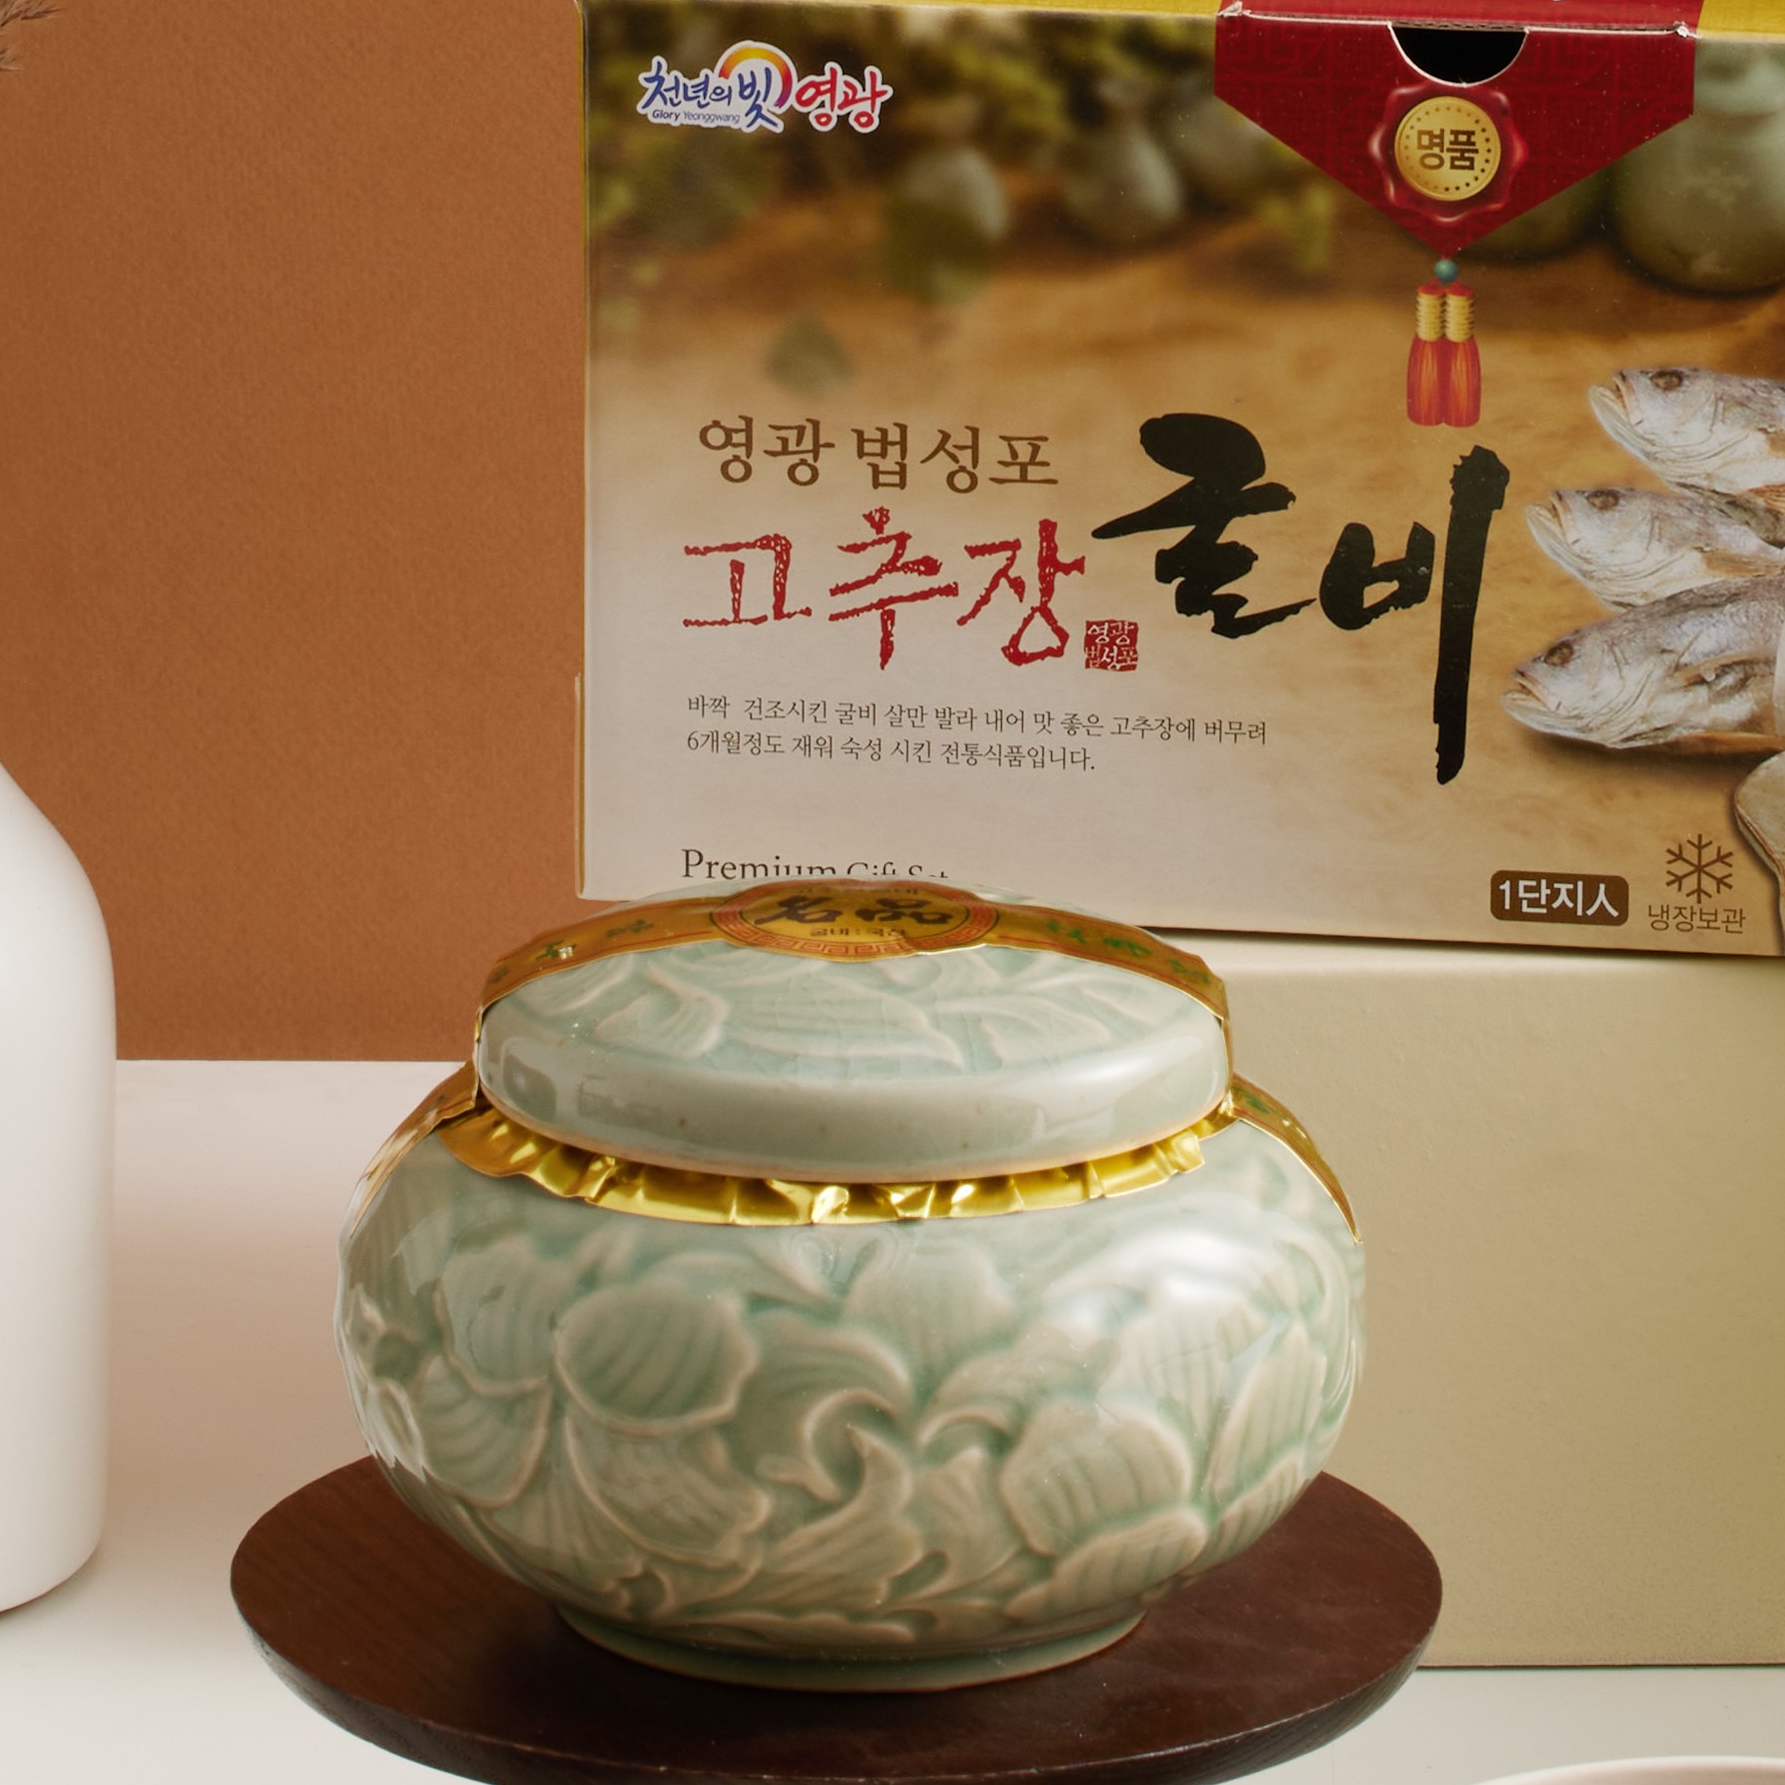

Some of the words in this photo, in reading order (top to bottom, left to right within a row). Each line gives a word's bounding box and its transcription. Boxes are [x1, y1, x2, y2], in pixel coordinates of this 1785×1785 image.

[642, 61, 732, 109] 천년의
[737, 66, 778, 128] 빛
[795, 67, 889, 128] 영광
[652, 109, 680, 122] Glory
[683, 111, 740, 124] Yeonggwang
[1416, 128, 1479, 172] 명품
[699, 415, 835, 488] 영광
[851, 420, 1059, 494] 법성포
[682, 505, 1087, 670] 고추장
[1091, 413, 1512, 785] 굴비
[687, 694, 731, 719] 바짝
[744, 697, 828, 724] 건조시킨
[834, 701, 877, 726] 굴비
[884, 703, 928, 729] 살만
[934, 706, 977, 732] 발라
[985, 708, 1025, 734] 내어
[1033, 711, 1055, 735] 맛
[1060, 712, 1104, 737] 좋은
[1110, 715, 1196, 741] 고추장에
[1204, 719, 1267, 746] 버무려
[687, 729, 785, 756] 6개월정도
[792, 734, 833, 759] 재워
[840, 736, 882, 762] 숙성
[890, 739, 932, 764] 시킨
[940, 741, 1095, 771] 전통식품입니다.
[1647, 904, 1746, 934] 냉장보관
